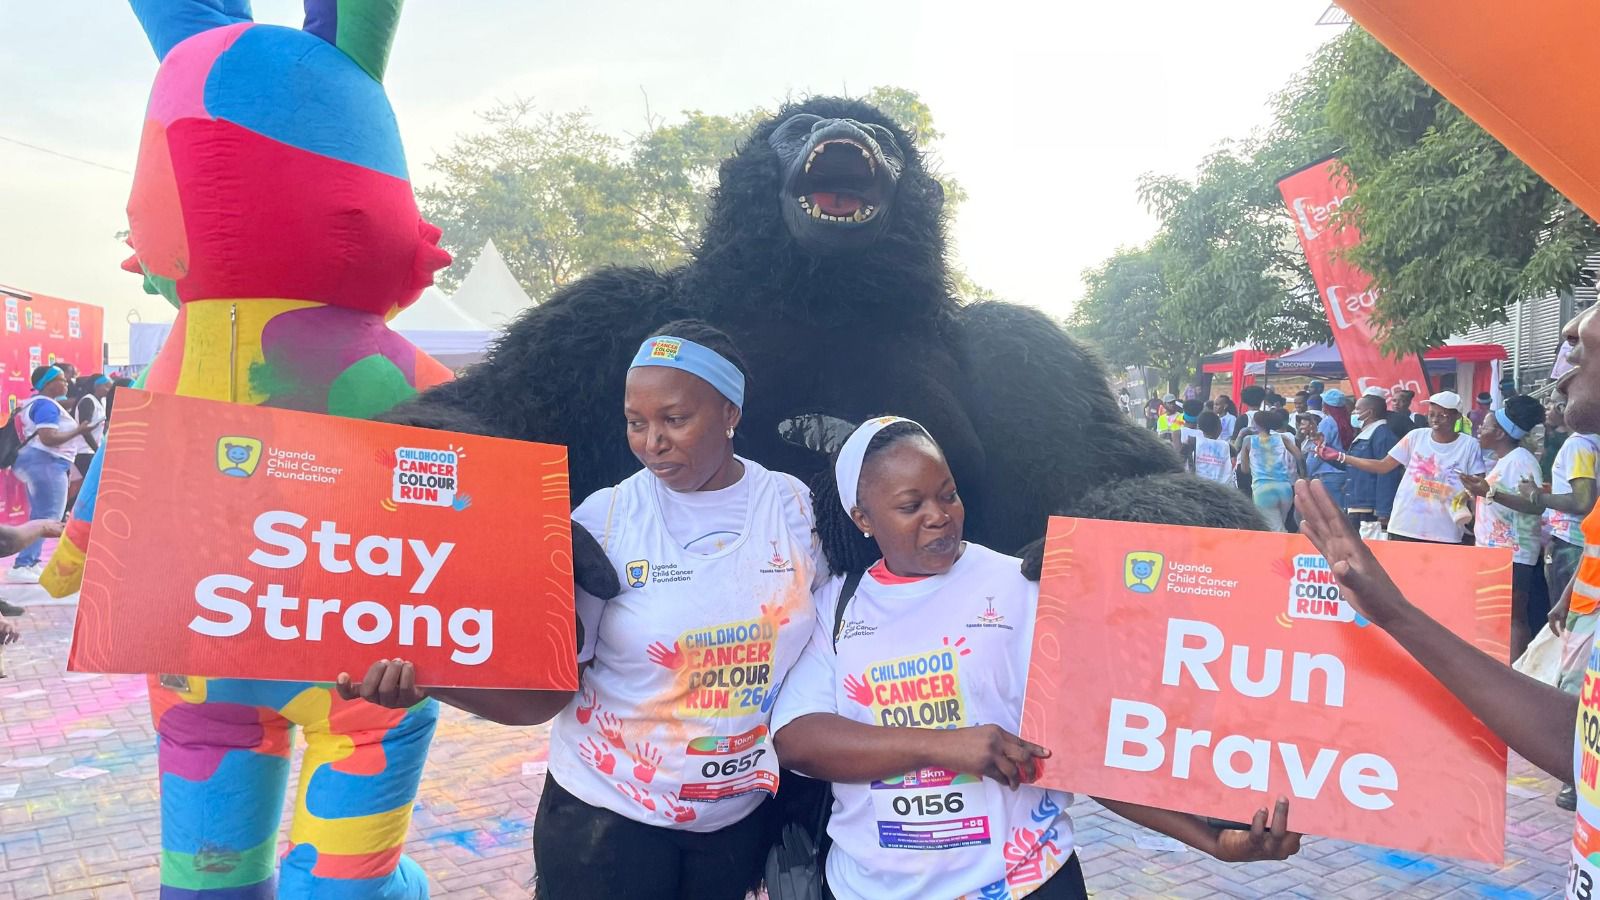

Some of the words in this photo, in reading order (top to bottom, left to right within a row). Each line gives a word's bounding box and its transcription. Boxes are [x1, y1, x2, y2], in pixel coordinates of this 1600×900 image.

[268, 447, 316, 461] Uganda
[399, 449, 455, 464] CHILDHOOD
[267, 458, 299, 470] Child
[301, 462, 344, 475] Cancer
[399, 459, 455, 477] CANCER
[266, 468, 336, 484] Foundation
[398, 472, 455, 490] COLOUR
[400, 485, 438, 502] RUN
[248, 510, 456, 595] Stay
[651, 563, 678, 571] Uganda
[1168, 561, 1213, 574] Uganda
[1297, 557, 1328, 569] CHILD
[652, 570, 670, 578] Child
[670, 569, 694, 577] Cancer
[652, 575, 692, 584] Foundation
[1167, 572, 1196, 584] Child
[1198, 575, 1239, 588] Cancer
[1166, 583, 1231, 598] Foundation
[1295, 583, 1345, 602] COLO
[1296, 598, 1339, 617] RUN
[187, 573, 494, 667] Strong
[685, 623, 774, 650] CHILDHOOD
[686, 642, 771, 669] CANCER
[1161, 617, 1346, 708] Run
[870, 652, 954, 683] CHILDHOOD
[688, 664, 770, 690] COLOUR
[875, 673, 957, 707] CANCER
[686, 689, 730, 710] RUN
[880, 698, 961, 728] COLOUR
[733, 734, 754, 747] 10km
[701, 749, 766, 779] 0657
[1104, 698, 1400, 812] Brave
[920, 769, 945, 779] 5km
[892, 792, 965, 816] 0156
